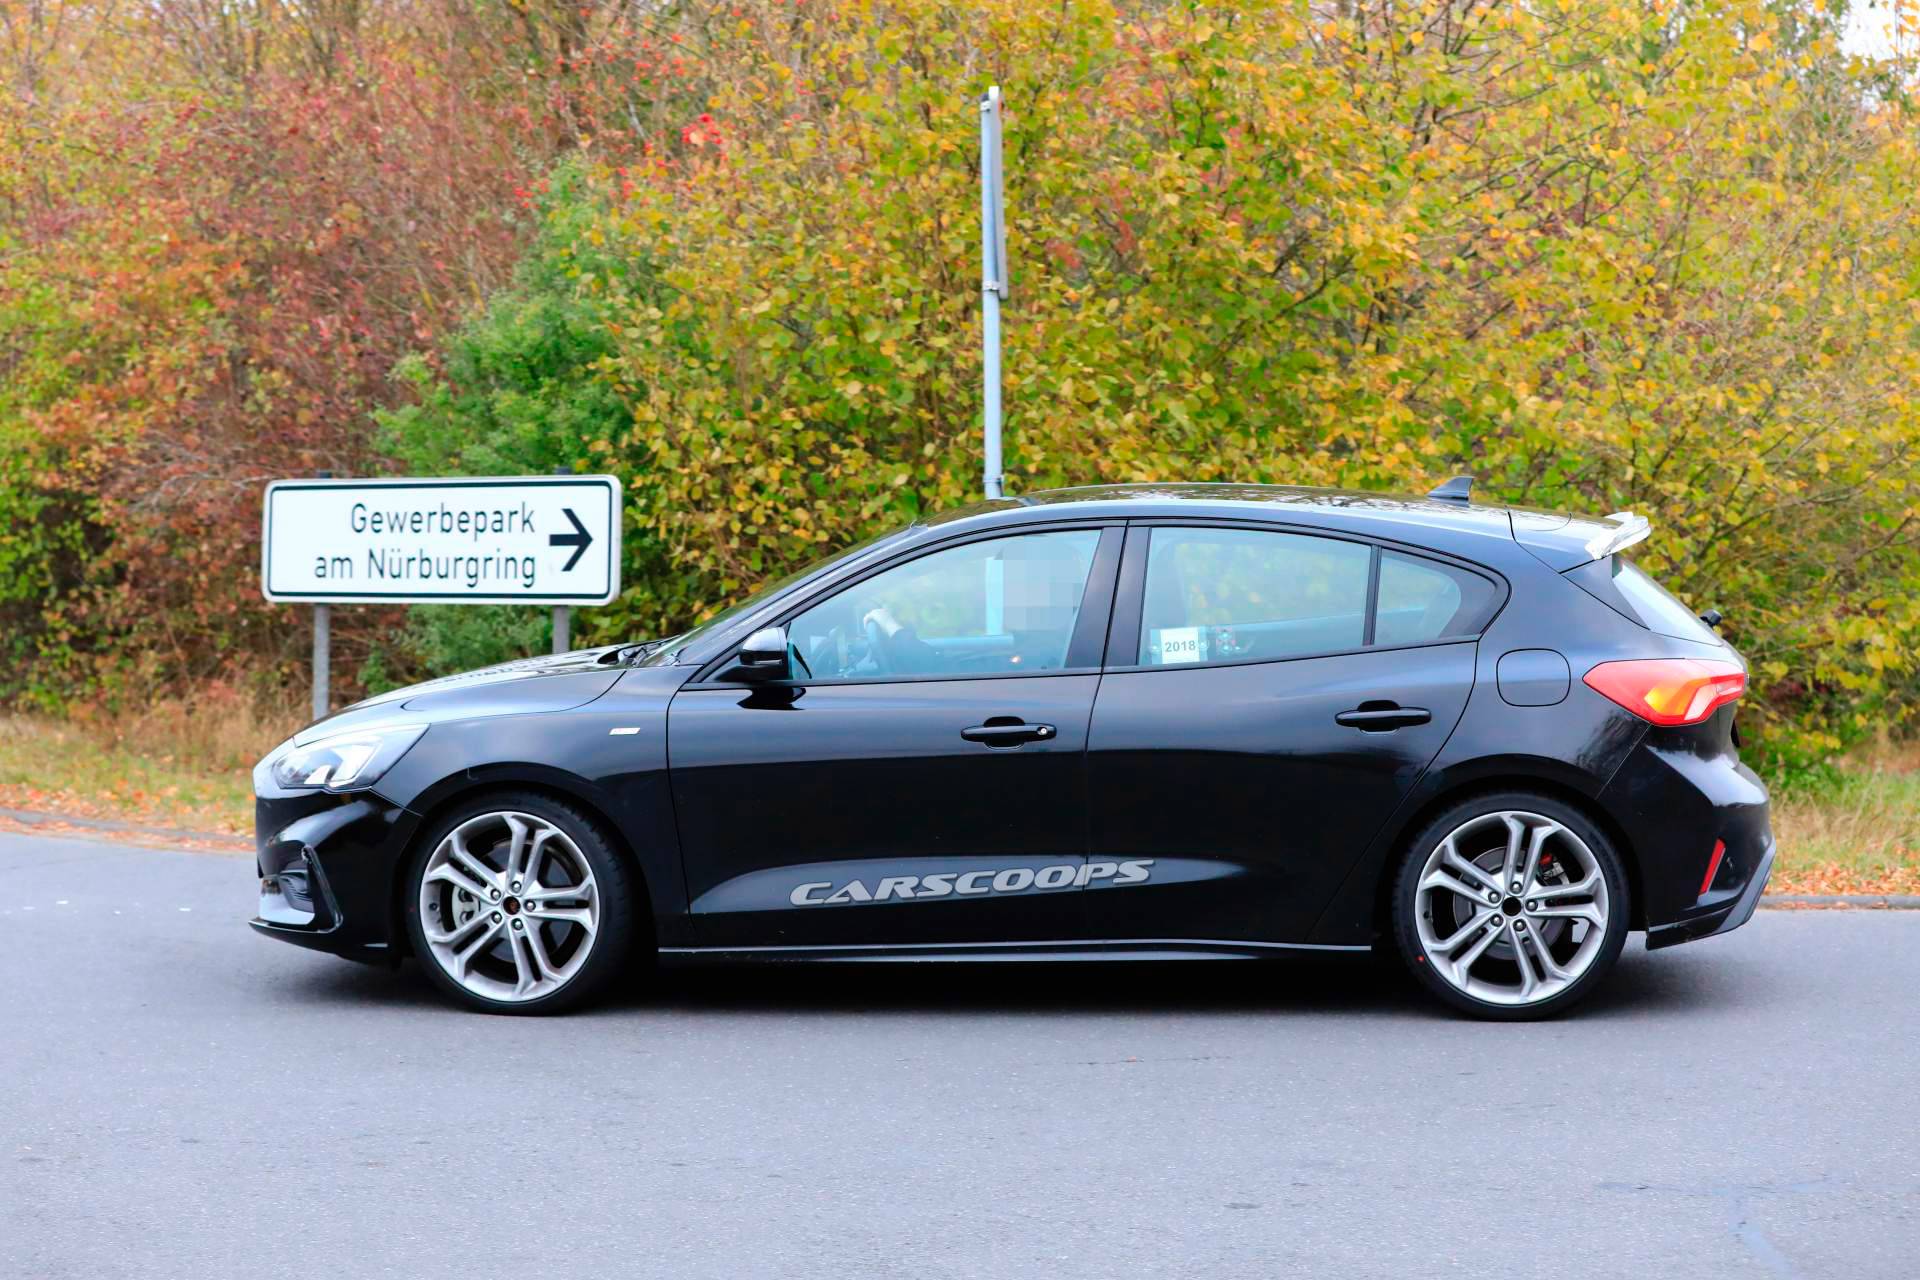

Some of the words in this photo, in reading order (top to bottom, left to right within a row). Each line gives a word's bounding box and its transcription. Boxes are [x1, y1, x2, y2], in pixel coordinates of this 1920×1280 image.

[351, 502, 535, 541] Gewerbepark
[314, 555, 352, 579] am
[368, 548, 536, 588] Nürburgring
[1165, 640, 1196, 652] 2018
